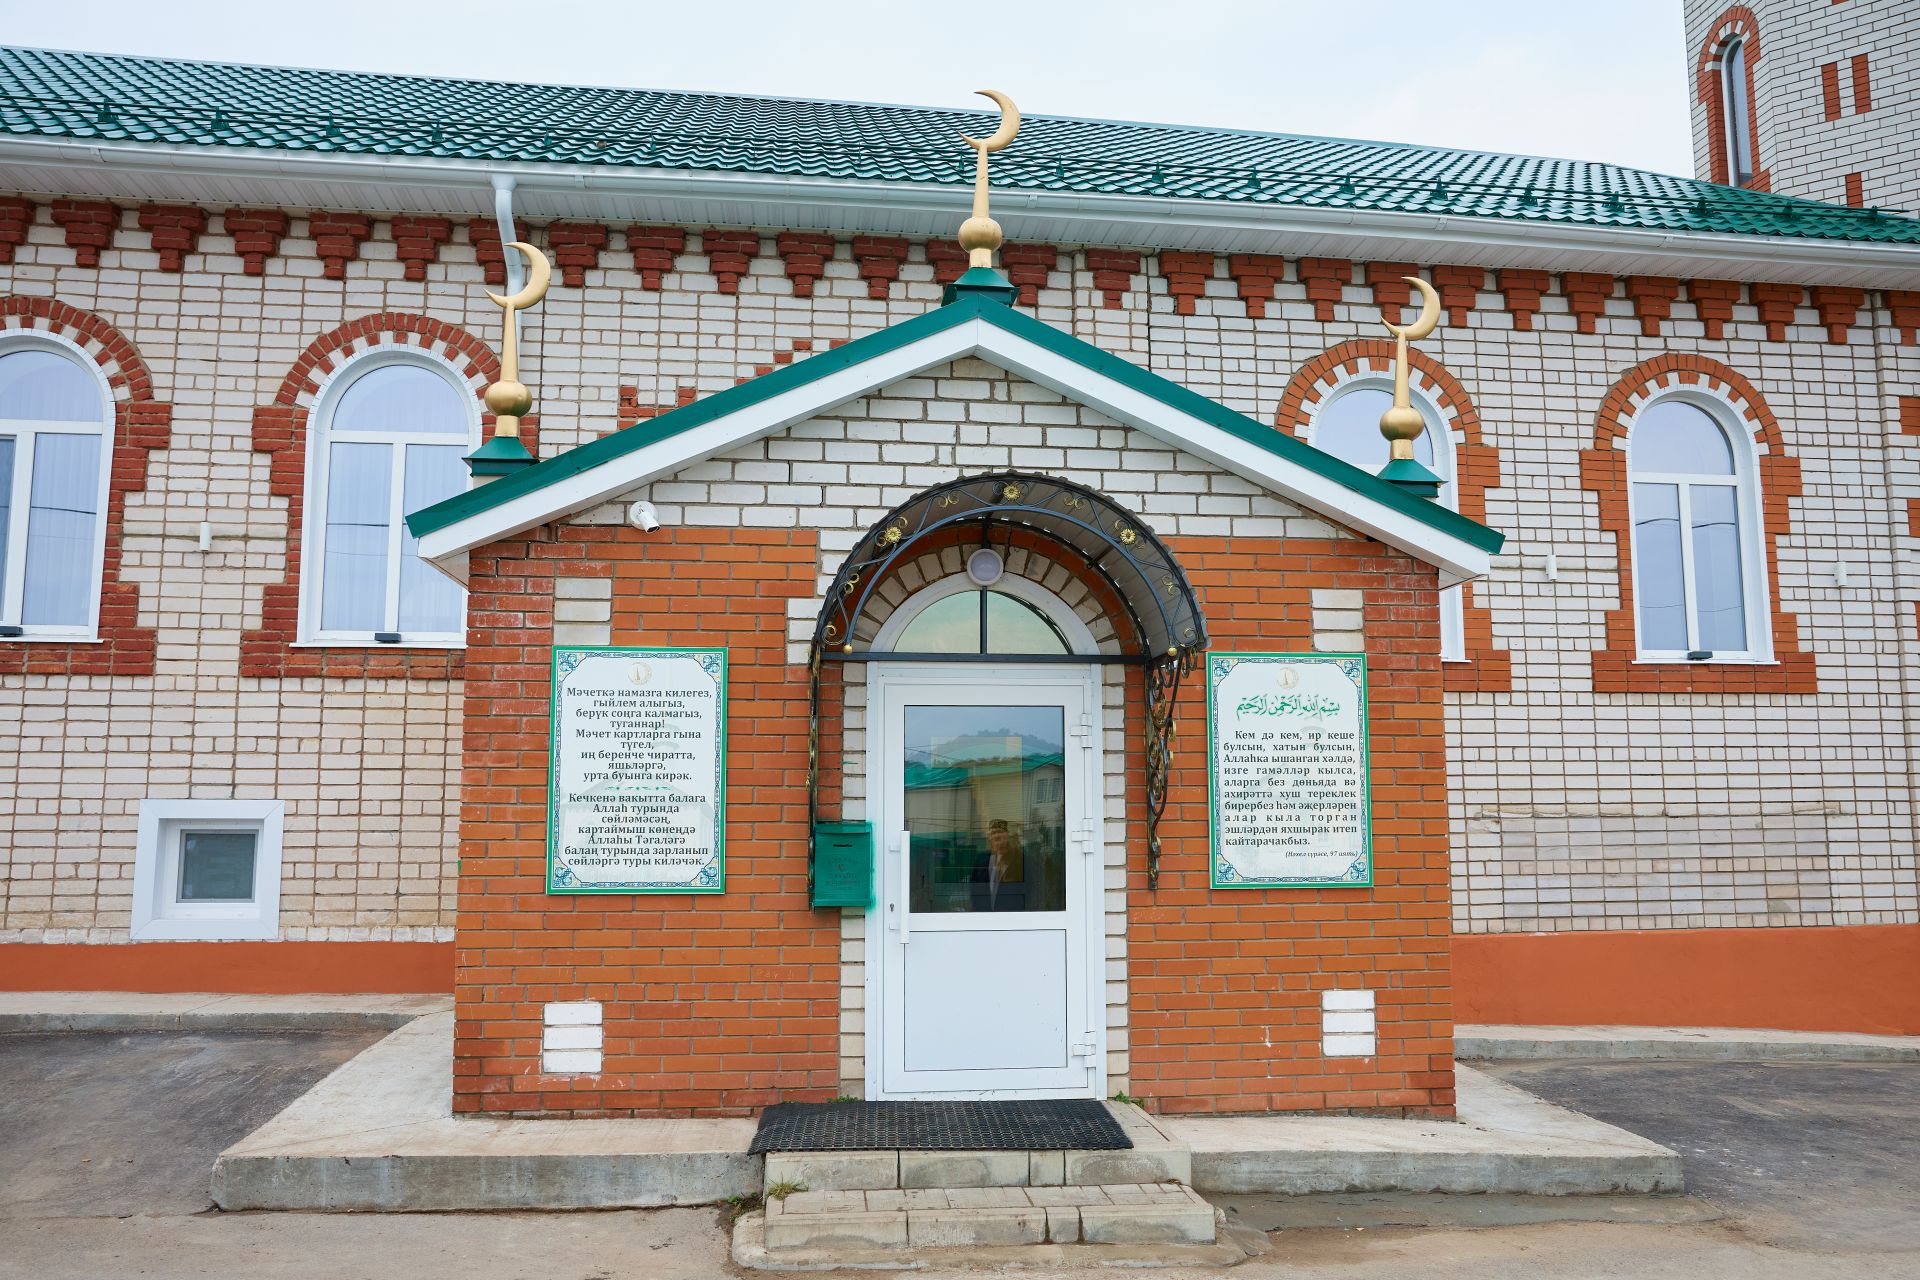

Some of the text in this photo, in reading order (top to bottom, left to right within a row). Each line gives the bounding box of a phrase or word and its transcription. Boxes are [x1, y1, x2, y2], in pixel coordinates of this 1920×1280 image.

[567, 687, 615, 696] Мәчеткә
[665, 690, 712, 698] килегез,
[594, 698, 685, 708] гыйлем алыгыз,
[576, 708, 702, 720] берүк соңга калмагыз,
[610, 719, 665, 730] туганнар!
[576, 729, 611, 738] Мәчет
[614, 731, 670, 741] картларга
[1235, 730, 1354, 742] Кем дә кем, ир кеше
[620, 742, 654, 751] түгел,
[1223, 742, 1266, 753] булсын,
[1313, 742, 1355, 753] булсын,
[581, 750, 695, 762] иң беренче чиратта,
[1223, 754, 1268, 763] Аллаһка
[1322, 756, 1355, 764] хәлдә,
[608, 762, 666, 772] яшьләргә,
[1256, 768, 1310, 777] гамәлләр
[584, 771, 692, 782] урта буынга кирәк.
[1224, 780, 1260, 788] аларга
[1268, 777, 1285, 787] без
[1292, 779, 1336, 788] дөньяда
[569, 793, 616, 802] Кечкенә
[668, 793, 706, 803] балага
[1224, 791, 1356, 800] ахирәттә хуш тереклек
[592, 803, 679, 815] Аллаһ турында
[1224, 800, 1356, 812] бирербез һәм әҗерләрен
[602, 814, 671, 825] сөйләмәсәң,
[1224, 814, 1357, 824] алар кыла торган
[578, 824, 646, 836] картаймыш
[1225, 826, 1278, 836] эшләрдән
[1281, 826, 1330, 836] яхшырак
[588, 835, 686, 844] Аллаһы Тәгаләгә
[1226, 836, 1310, 848] кайтарачакбыз.
[564, 846, 708, 857] балаң турында зарланып
[568, 856, 620, 868] сөйләргә
[622, 858, 651, 868] туры
